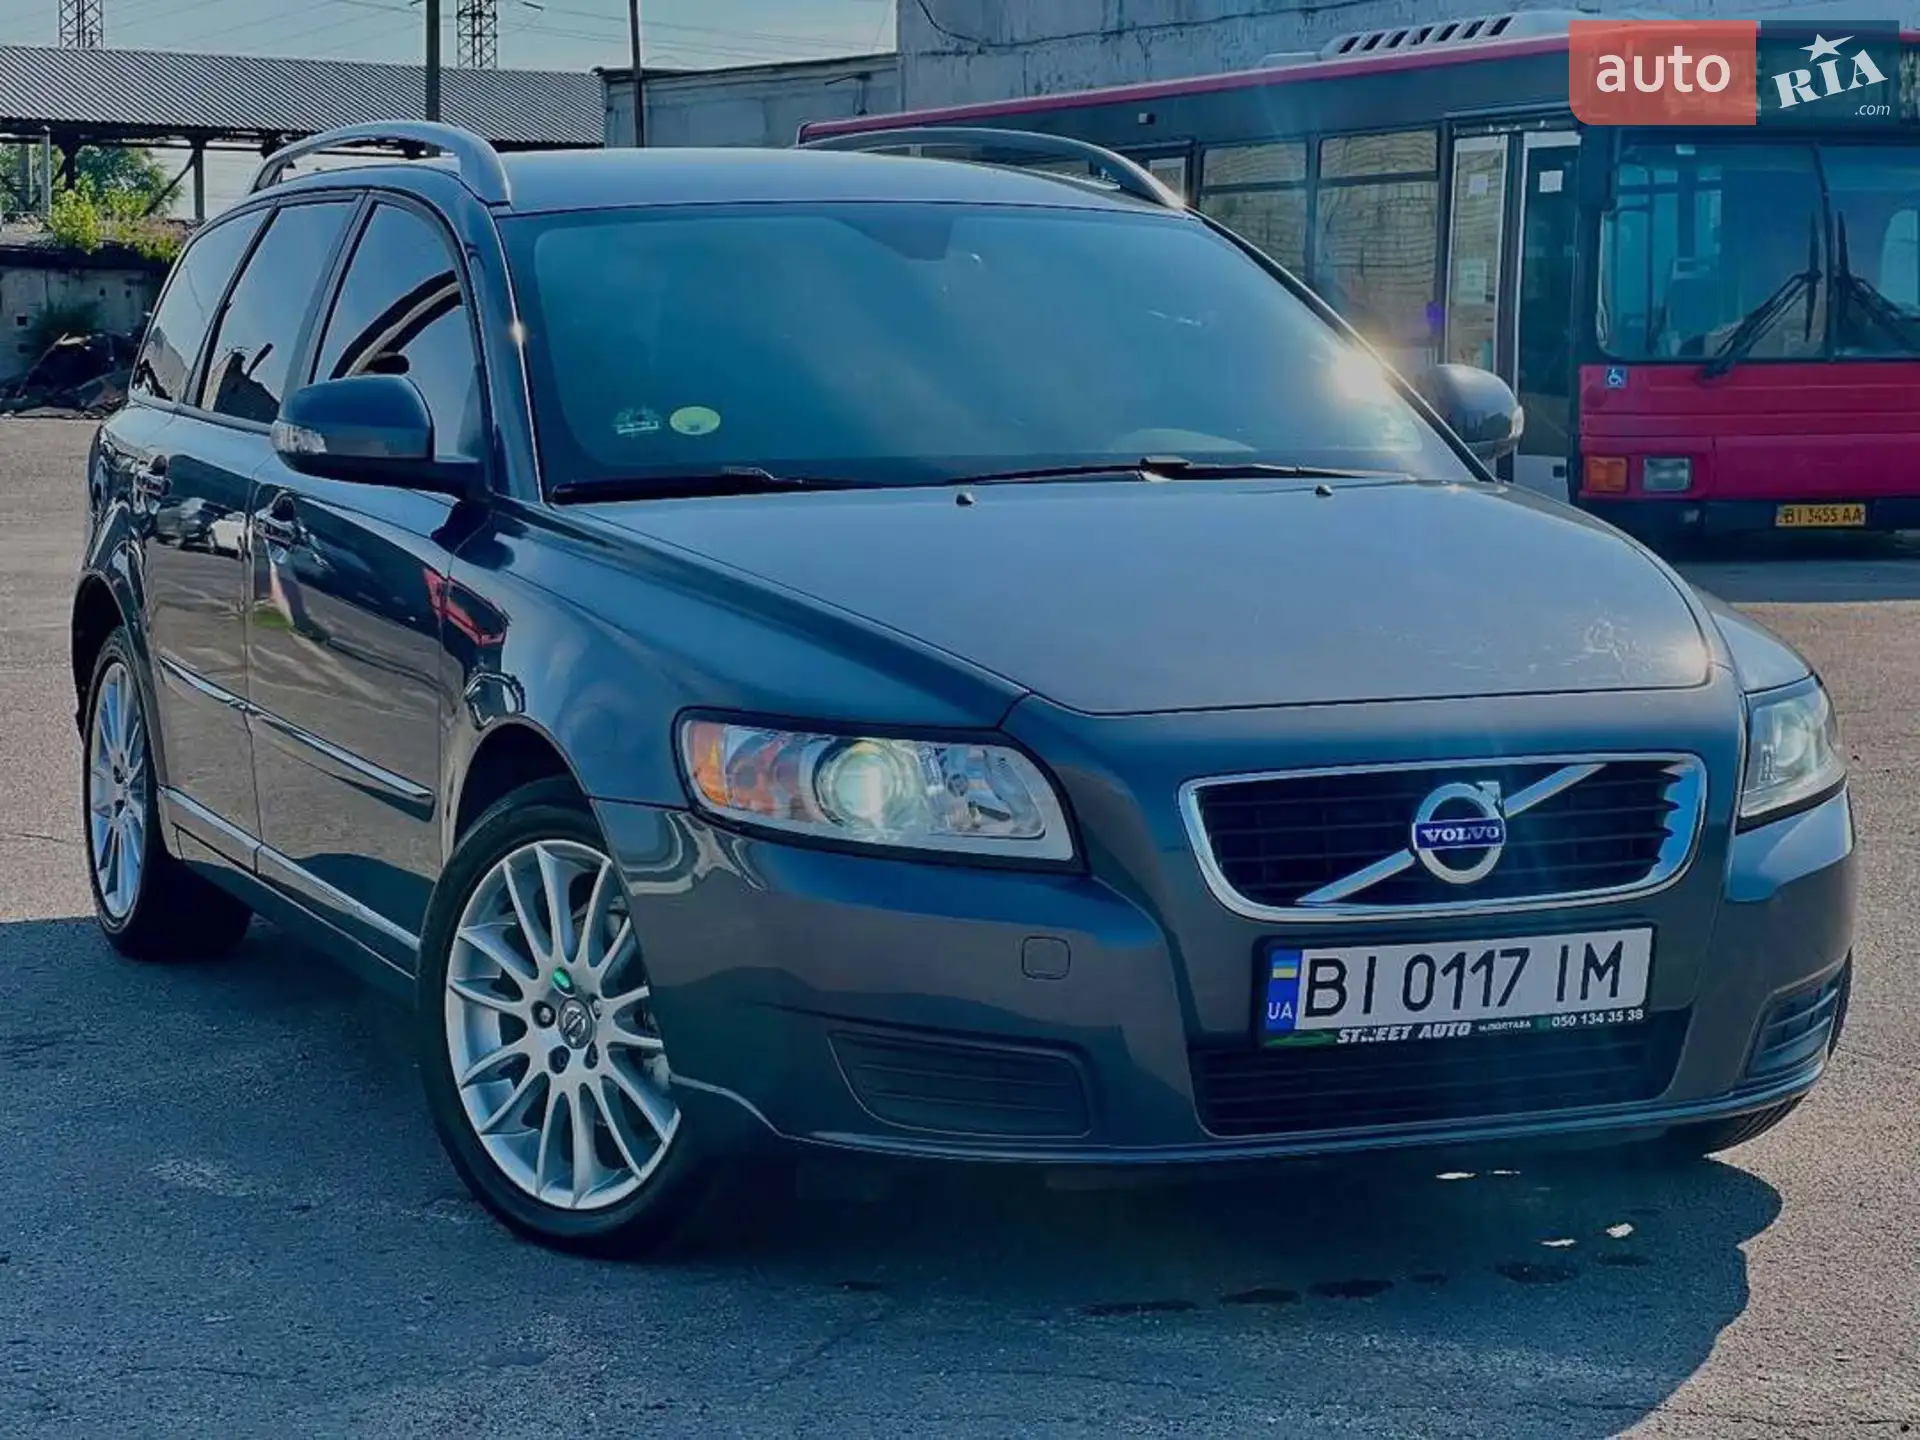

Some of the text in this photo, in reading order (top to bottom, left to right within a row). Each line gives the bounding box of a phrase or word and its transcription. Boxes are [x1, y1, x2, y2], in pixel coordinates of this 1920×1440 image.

[1421, 826, 1500, 843] VOLVO
[1304, 940, 1625, 1019] BI 0117 IM
[1268, 1001, 1294, 1020] UA
[1551, 1014, 1577, 1028] 050
[1580, 1012, 1605, 1026] 134
[1607, 1010, 1625, 1023] 35
[1418, 1021, 1473, 1040] AUTO
